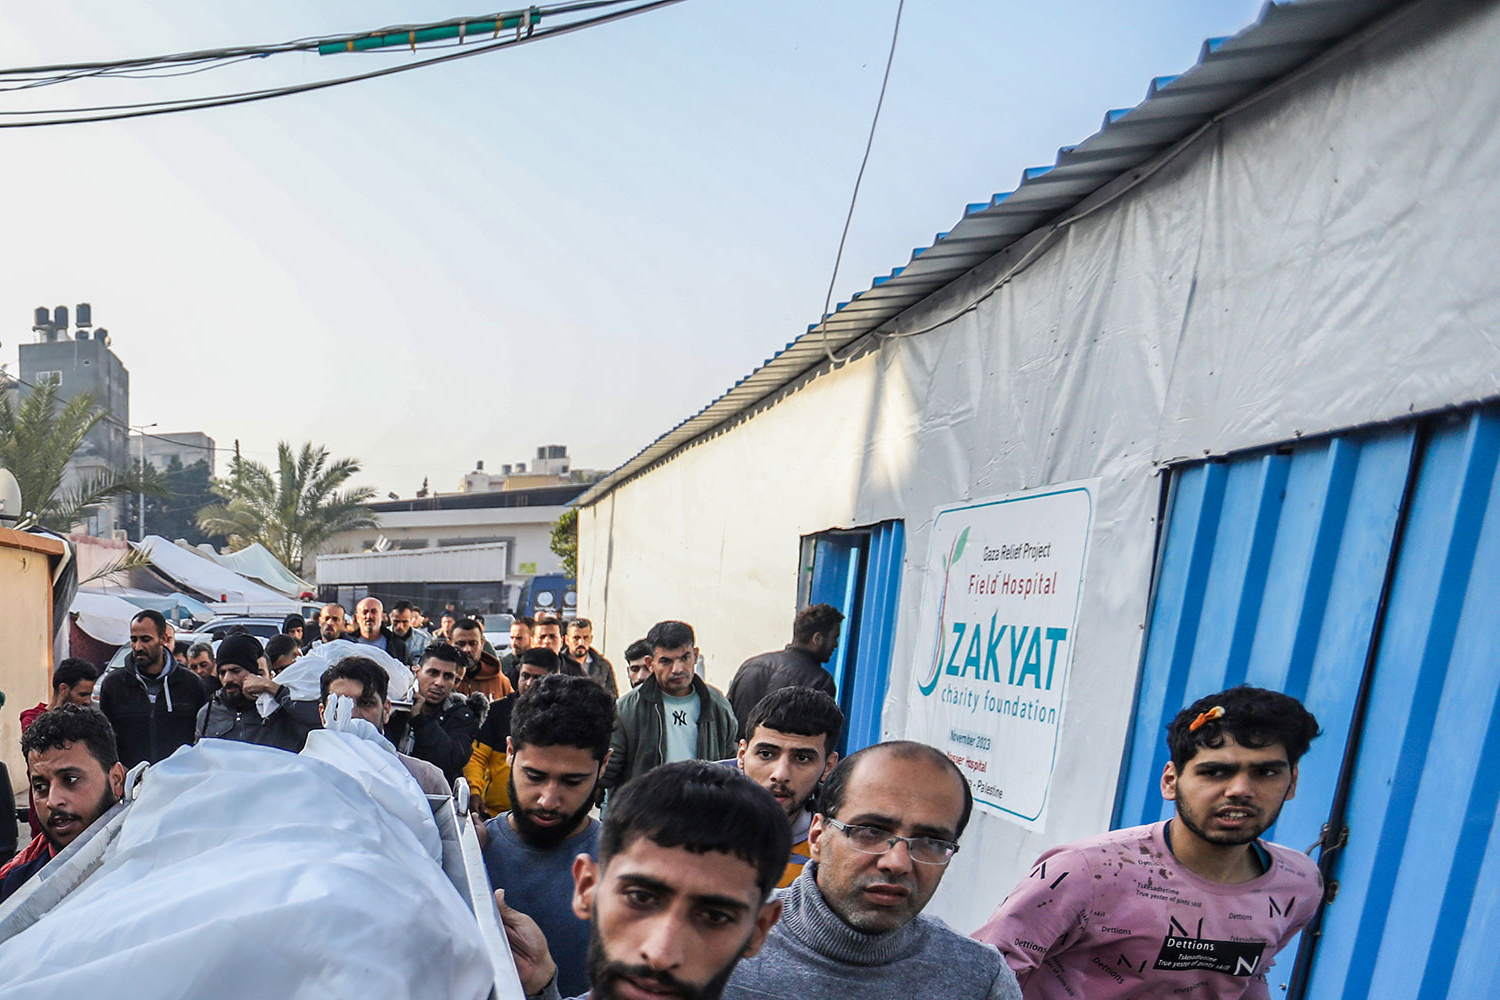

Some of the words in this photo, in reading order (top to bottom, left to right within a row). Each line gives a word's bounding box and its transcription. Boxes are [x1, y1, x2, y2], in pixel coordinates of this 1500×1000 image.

[983, 546, 999, 561] Gaza
[1000, 544, 1022, 560] Relief
[1023, 542, 1051, 562] Project
[968, 573, 999, 595] Field
[1001, 571, 1057, 600] Hospital
[945, 608, 1068, 691] ZAKYAT
[941, 683, 980, 714] charity
[983, 689, 1056, 725] foundation
[672, 710, 688, 726] NY
[950, 730, 976, 746] November
[966, 756, 988, 773] Hospital
[976, 779, 1003, 799] Palestine
[1101, 925, 1132, 935] Dettions
[1014, 938, 1049, 953] Dettions
[1166, 938, 1215, 951] Dettions
[1091, 956, 1125, 985] Dettions
[1233, 955, 1259, 976] N
